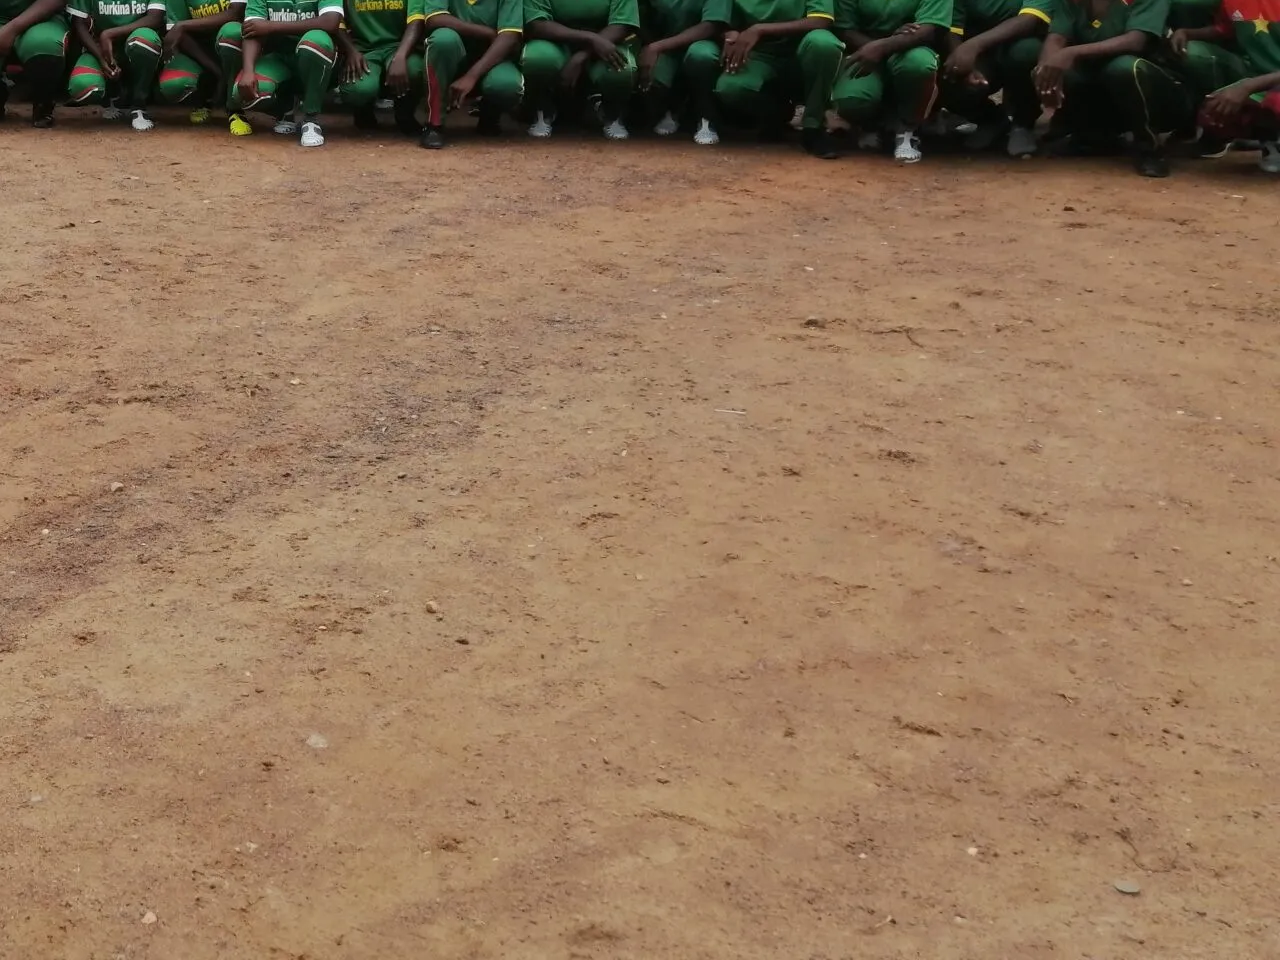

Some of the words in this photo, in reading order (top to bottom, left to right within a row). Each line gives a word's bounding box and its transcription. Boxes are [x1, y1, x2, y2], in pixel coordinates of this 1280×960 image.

[98, 1, 130, 15] Burkina
[131, 0, 147, 14] Fas
[268, 8, 297, 22] Burkin
